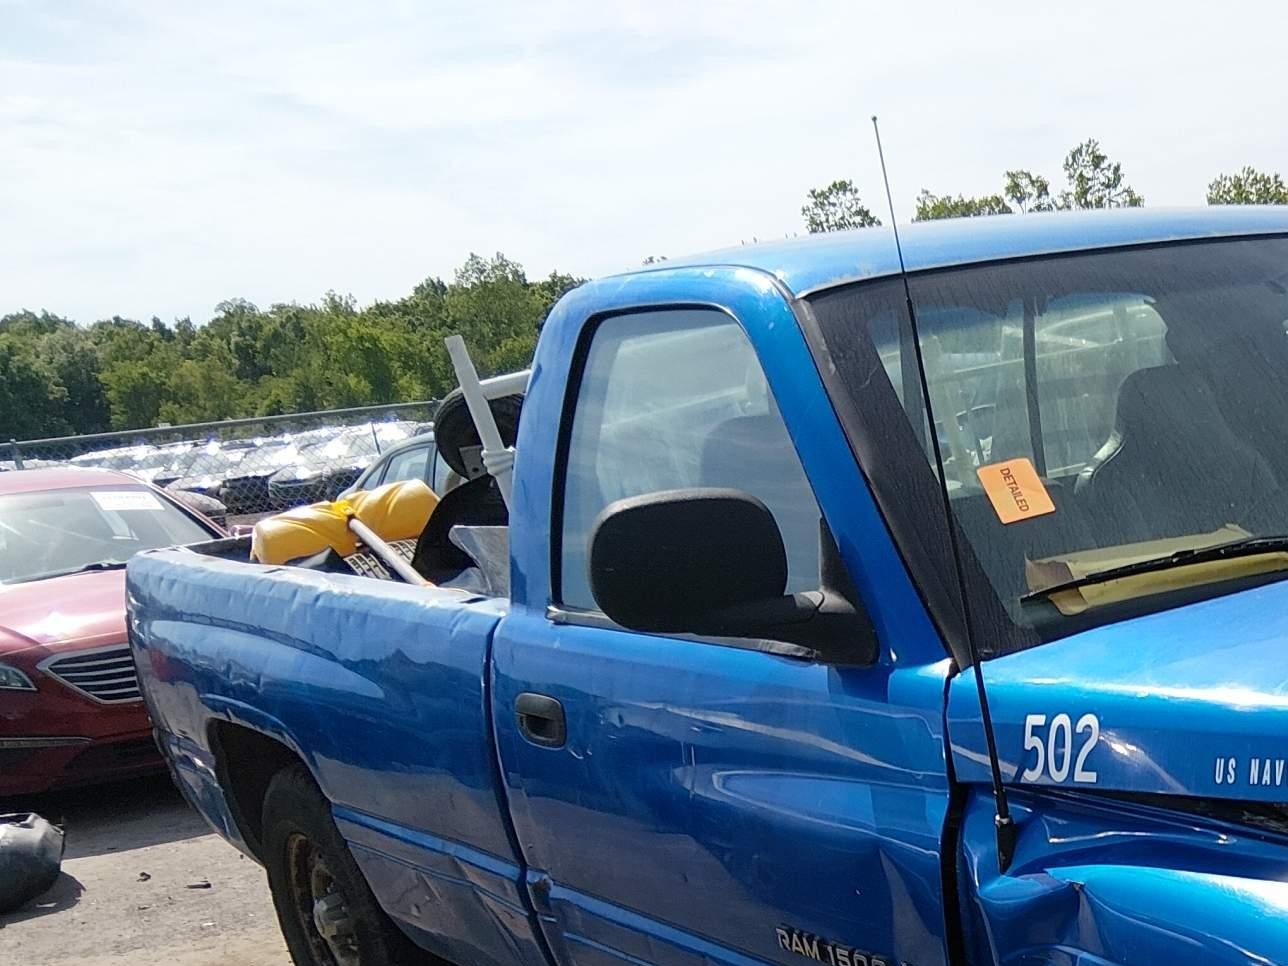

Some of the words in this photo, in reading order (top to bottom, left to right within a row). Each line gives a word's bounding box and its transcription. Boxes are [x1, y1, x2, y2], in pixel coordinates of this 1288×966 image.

[1000, 467, 1030, 512] DETAILED
[1020, 713, 1099, 784] 502
[1215, 757, 1236, 785] US
[775, 927, 821, 961] RAM
